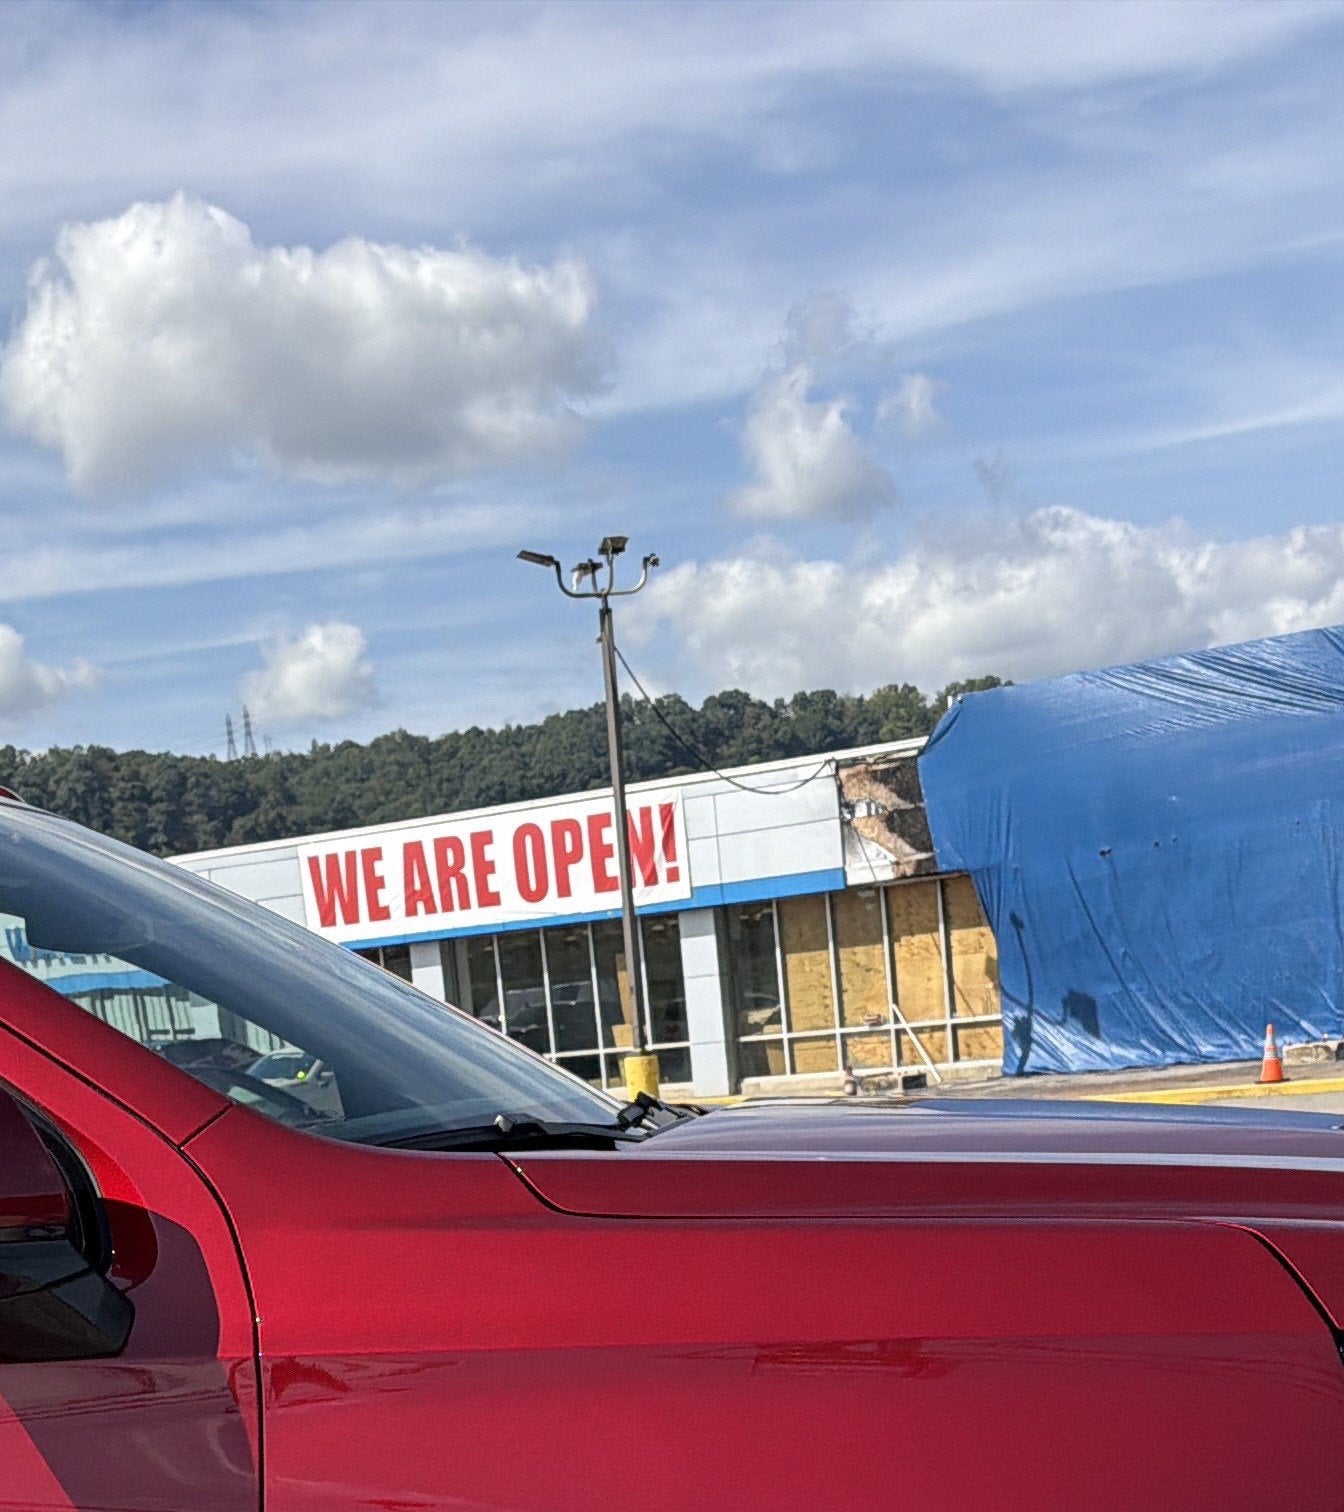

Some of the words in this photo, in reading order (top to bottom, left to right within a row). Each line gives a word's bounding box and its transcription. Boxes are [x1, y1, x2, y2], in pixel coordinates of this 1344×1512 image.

[308, 846, 391, 928] WE
[403, 829, 502, 918] ARE
[513, 802, 680, 904] OPEN!
